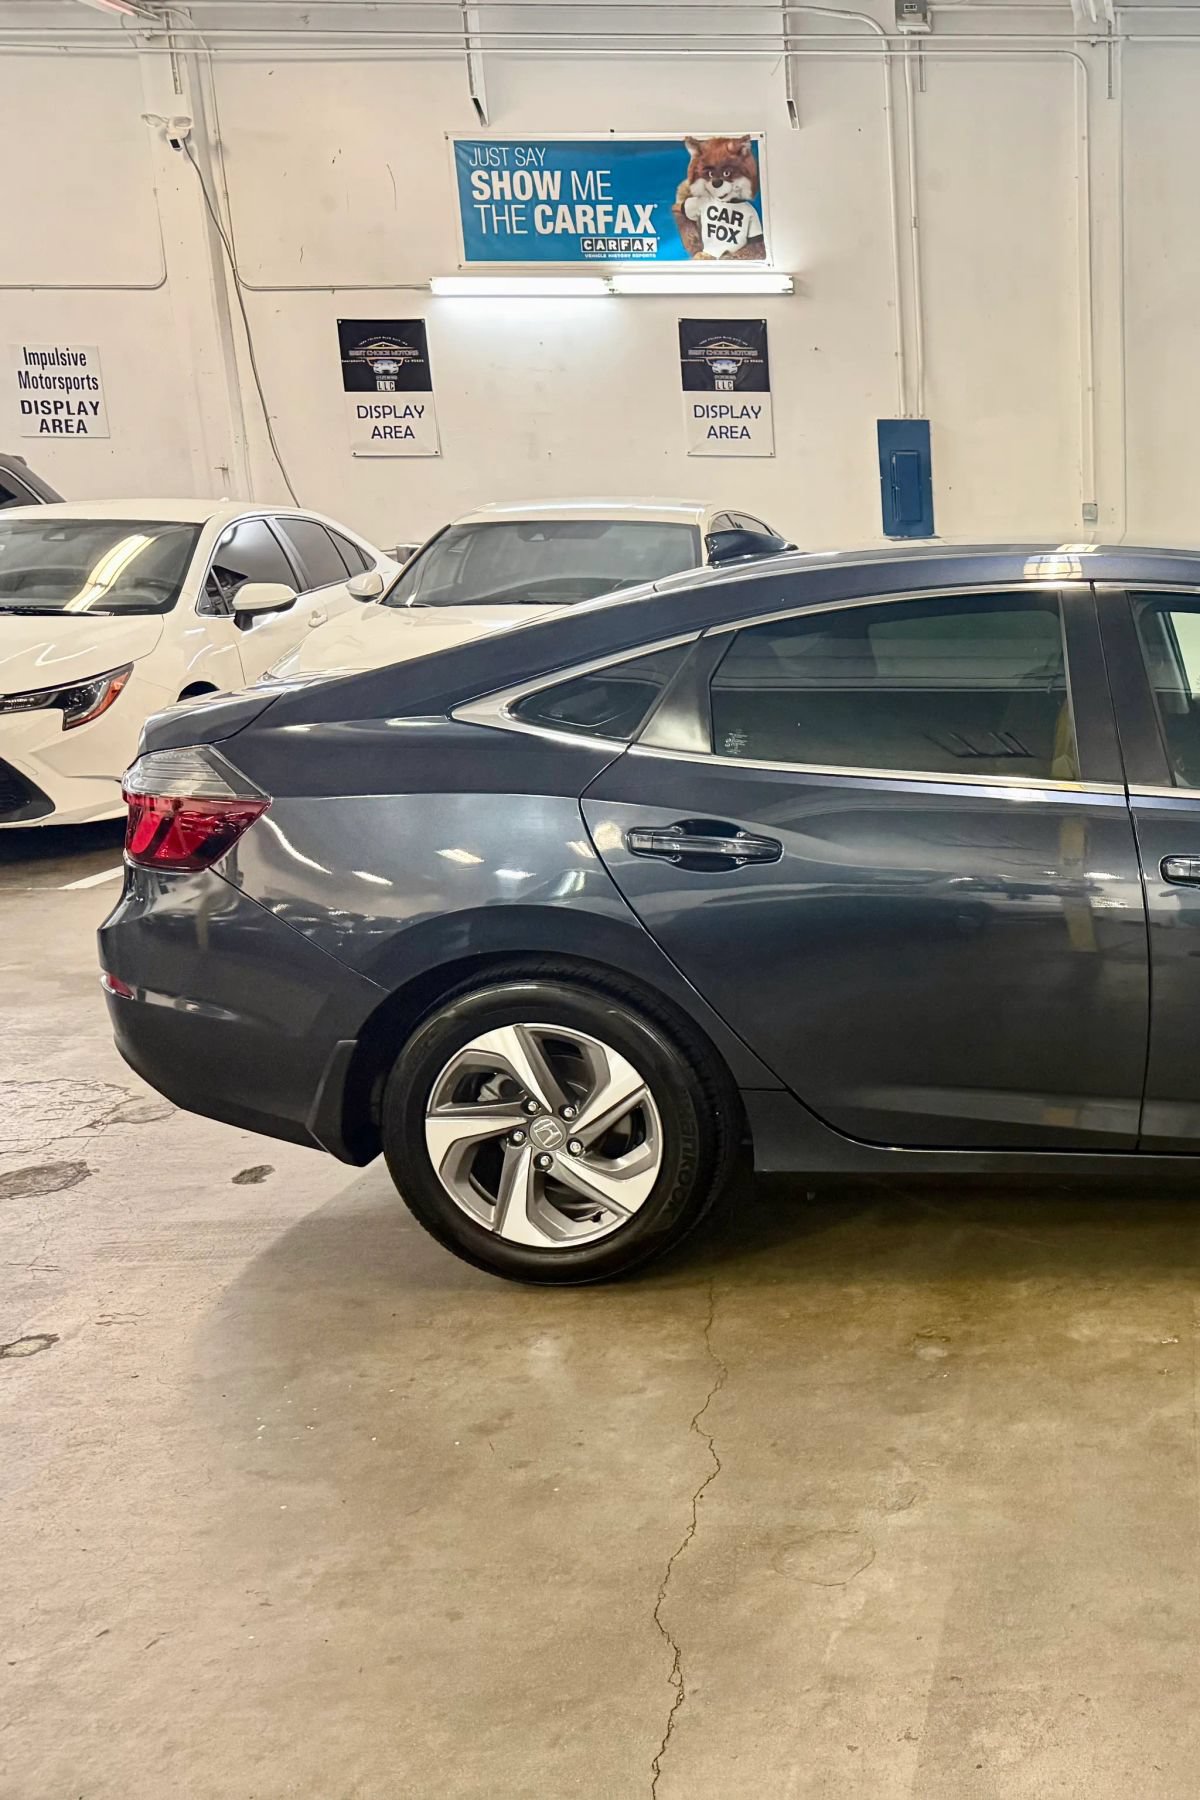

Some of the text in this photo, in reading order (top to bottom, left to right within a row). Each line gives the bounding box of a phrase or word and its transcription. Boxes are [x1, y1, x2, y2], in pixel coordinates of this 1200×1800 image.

[469, 147, 546, 167] JUST SAY
[470, 170, 613, 201] SHOW ME
[473, 204, 528, 235] THE
[706, 205, 744, 228] CAR
[707, 223, 741, 245] FOX
[22, 346, 87, 370] Impulsive
[17, 370, 99, 395] Motorsports
[20, 400, 100, 416] DISPLAY
[356, 405, 425, 419] DISPLAY
[693, 404, 762, 419] DISPLAY
[39, 418, 88, 434] AREA
[371, 425, 416, 439] AREA
[706, 425, 751, 440] AREA
